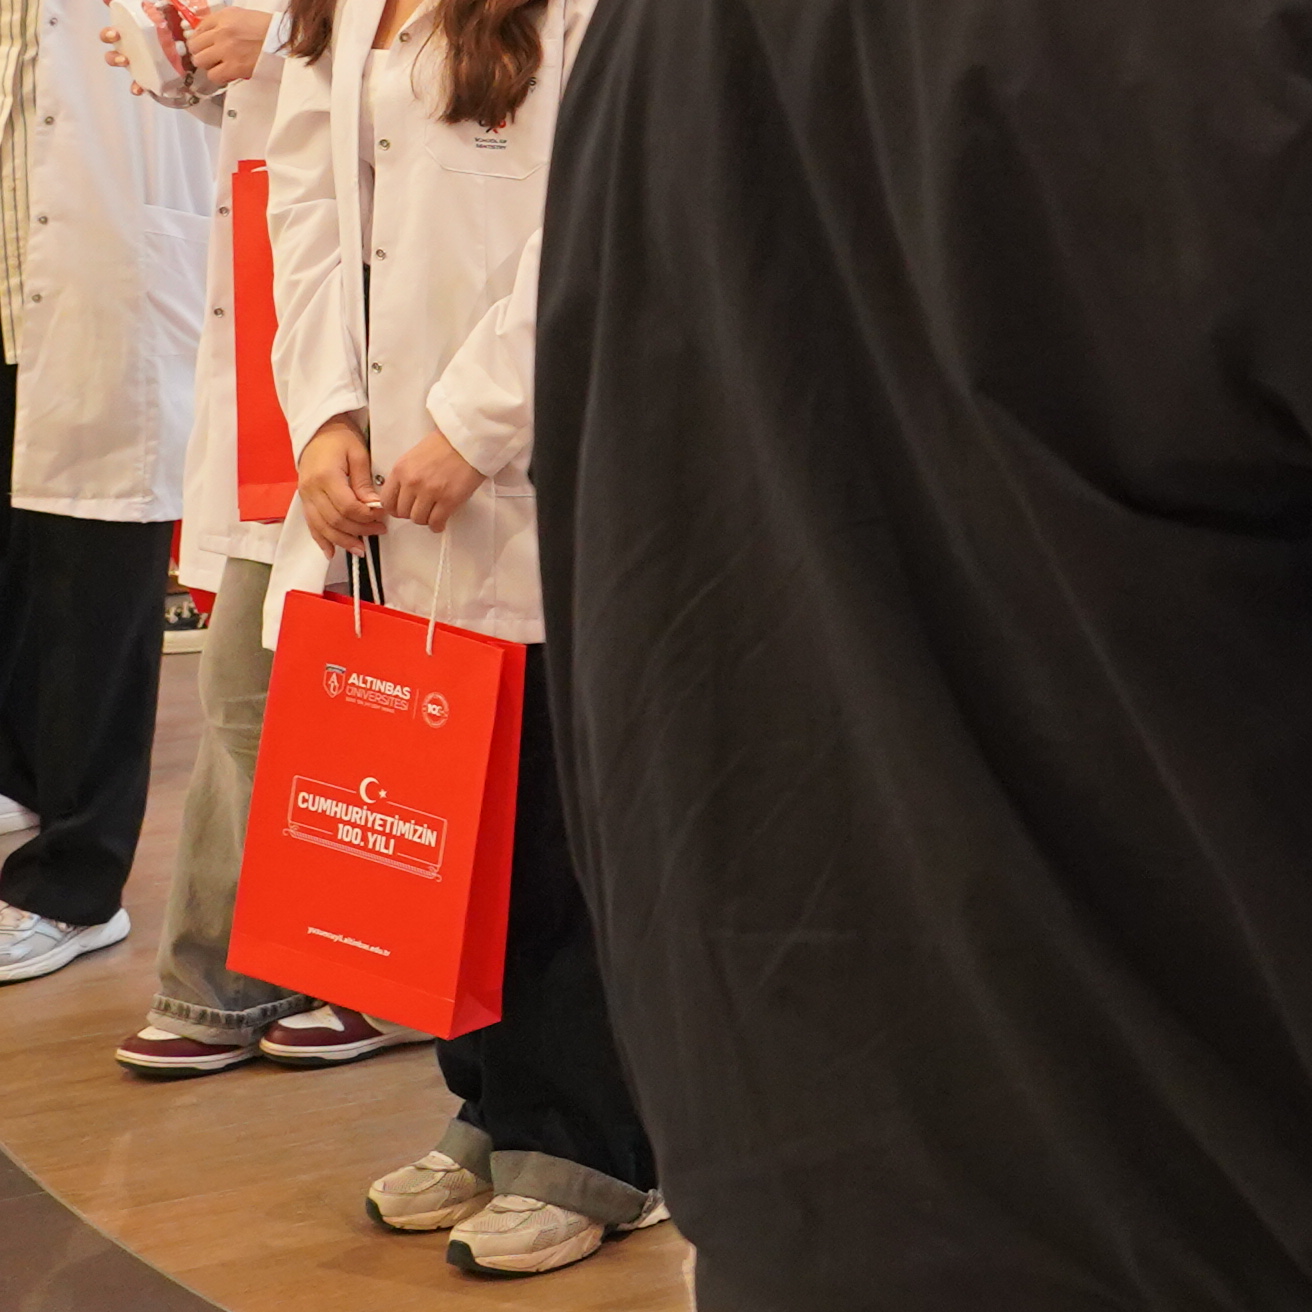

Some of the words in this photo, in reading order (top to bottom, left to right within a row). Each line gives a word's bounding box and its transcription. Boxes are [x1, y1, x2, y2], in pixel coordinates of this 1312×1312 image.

[297, 791, 437, 847] CUMHURİYETİMİZİN
[337, 823, 365, 846] 100.
[367, 831, 395, 855] YILI
